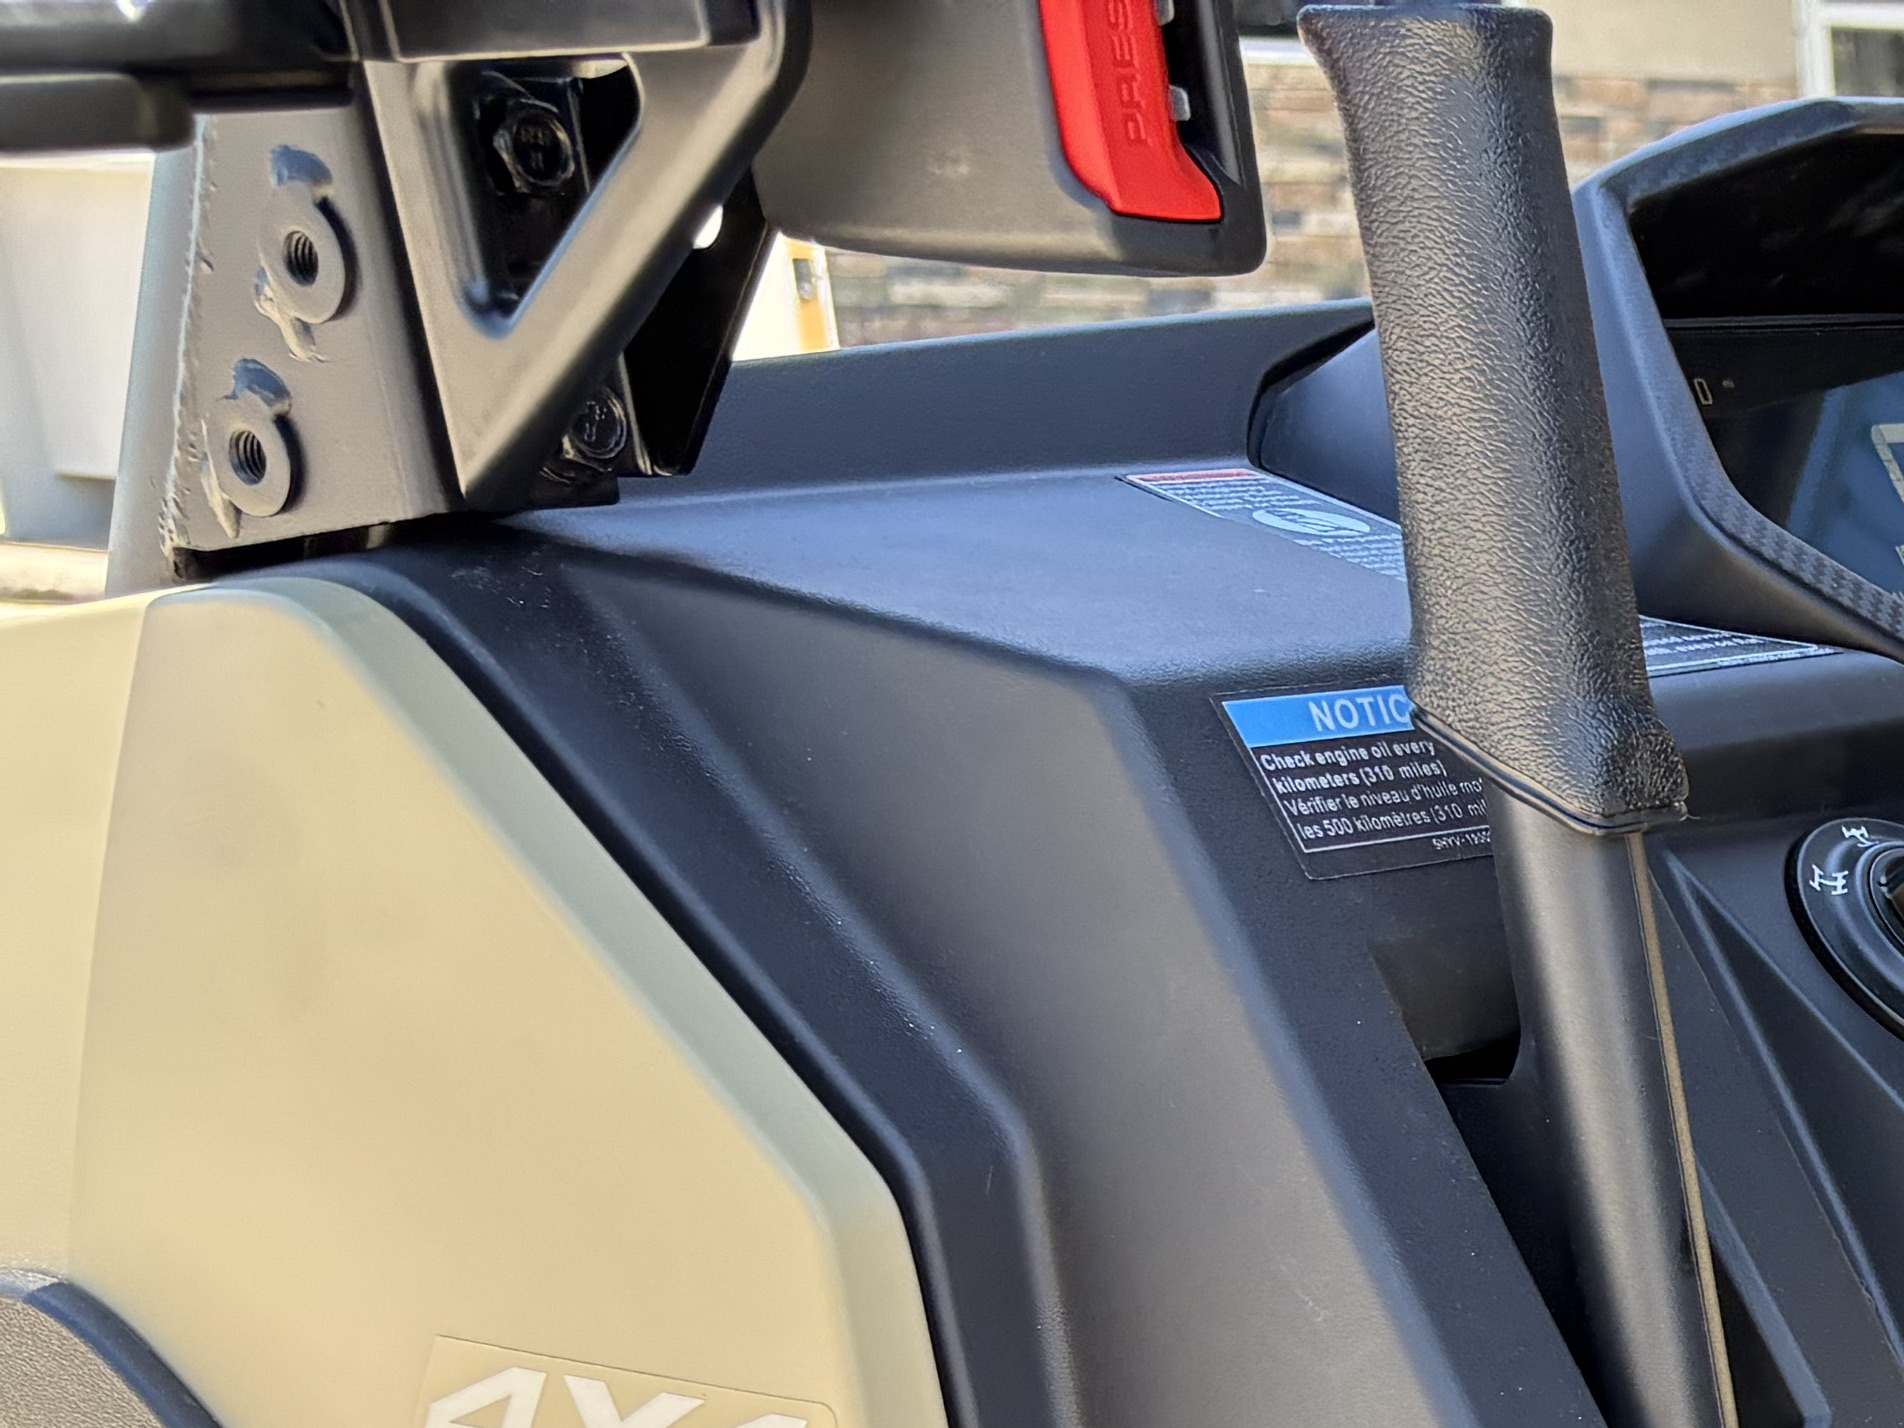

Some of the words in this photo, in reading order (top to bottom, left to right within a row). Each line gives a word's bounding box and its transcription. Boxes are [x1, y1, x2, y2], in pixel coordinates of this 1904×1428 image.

[1308, 693, 1411, 732] NOTIC
[1260, 750, 1314, 771] Check
[1317, 745, 1369, 767] engine
[1371, 740, 1393, 759] oil
[1392, 740, 1436, 757] every
[1272, 770, 1360, 795] kilometers
[1359, 764, 1395, 787] (310
[1399, 759, 1448, 779] miles)
[1342, 792, 1359, 811] le
[1360, 787, 1410, 808] niveau
[1296, 821, 1324, 840] les
[1323, 815, 1354, 836] 500
